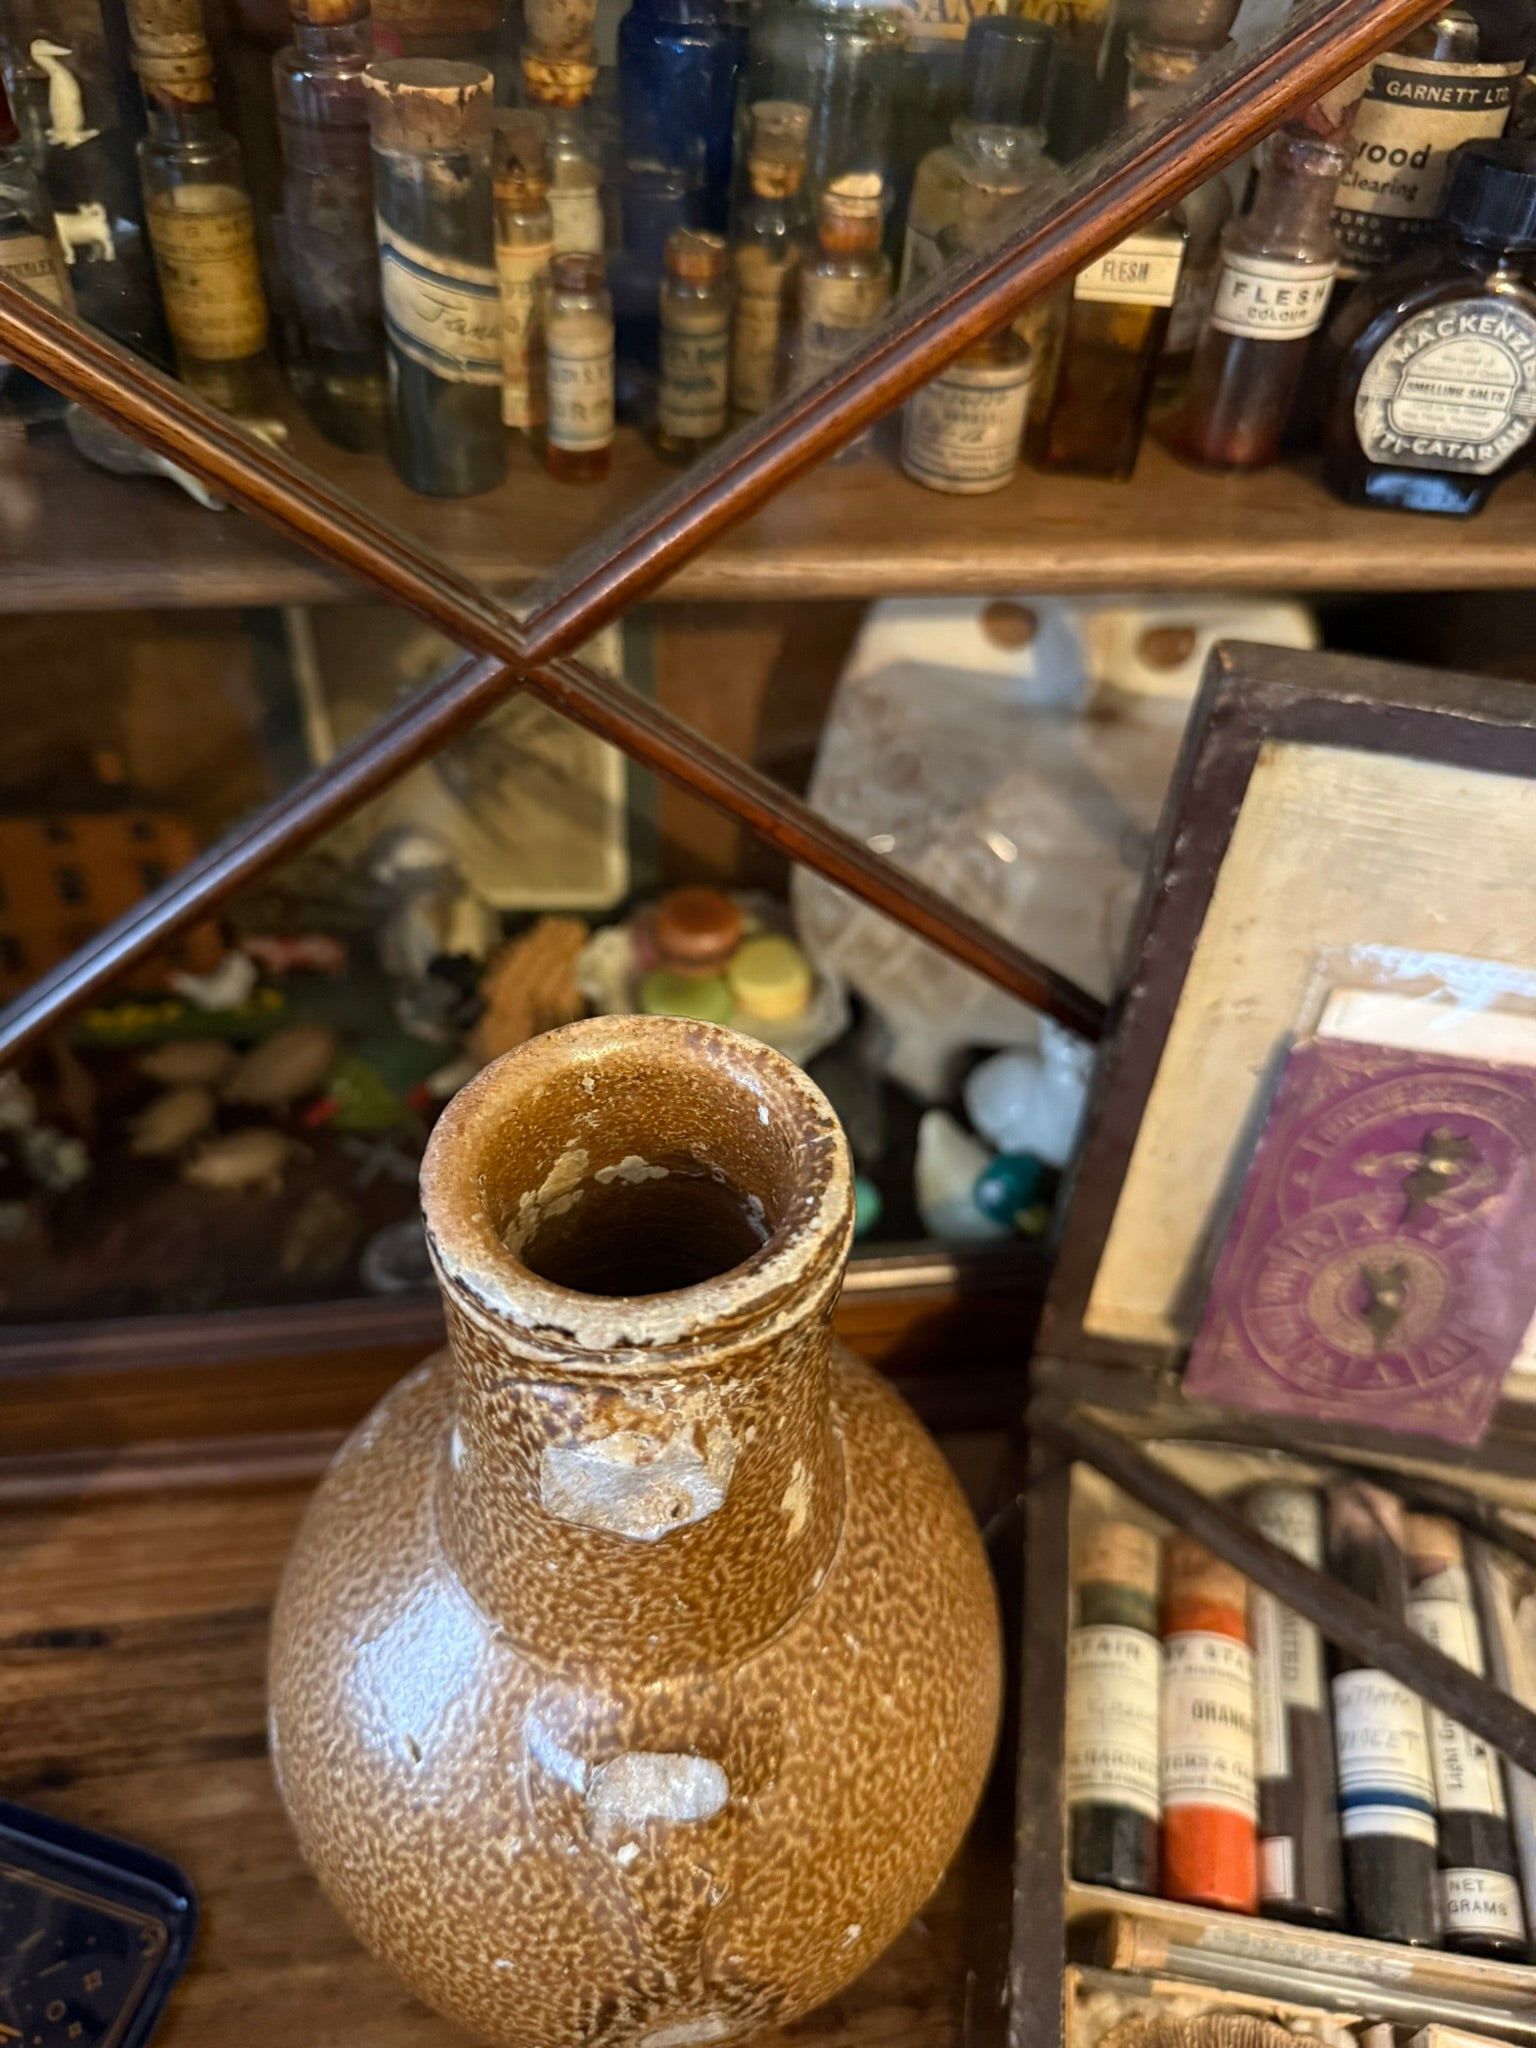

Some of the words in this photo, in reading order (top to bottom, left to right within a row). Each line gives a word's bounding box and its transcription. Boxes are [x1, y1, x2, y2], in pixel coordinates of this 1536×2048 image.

[1386, 81, 1479, 104] GARNETT
[1102, 260, 1149, 284] FLESH
[1232, 281, 1326, 307] FLESH
[1448, 1878, 1485, 1893] NET
